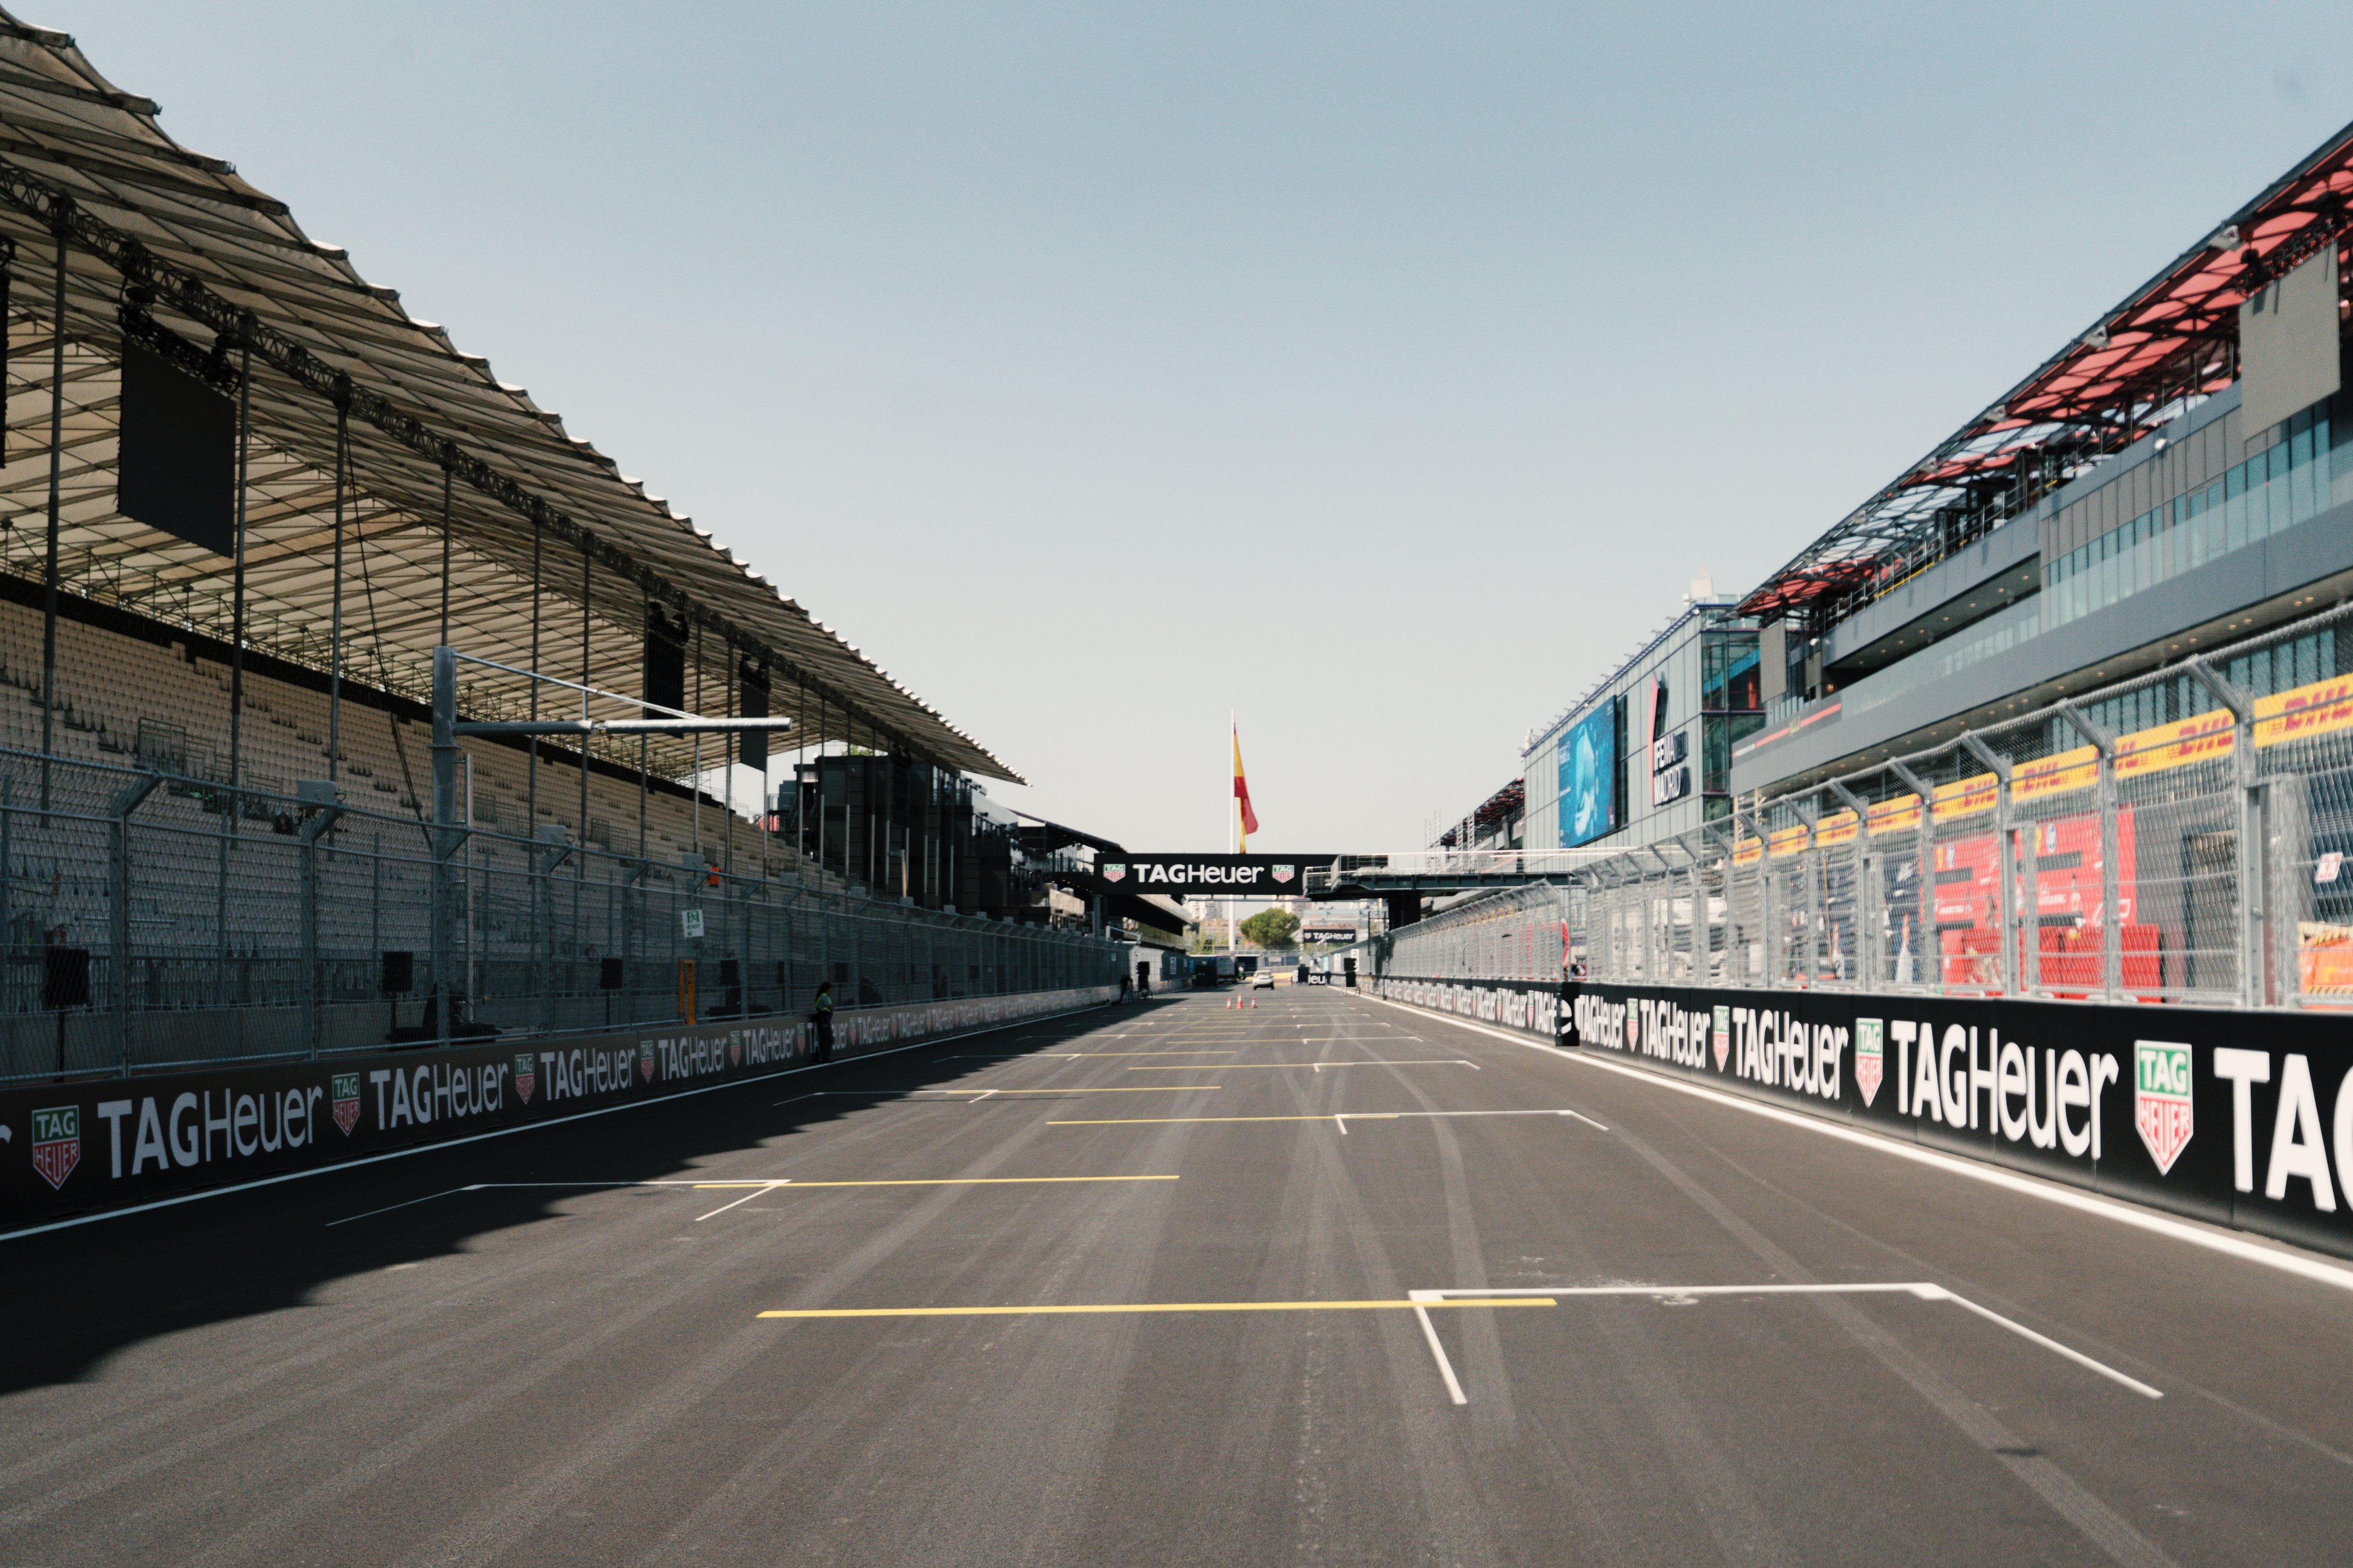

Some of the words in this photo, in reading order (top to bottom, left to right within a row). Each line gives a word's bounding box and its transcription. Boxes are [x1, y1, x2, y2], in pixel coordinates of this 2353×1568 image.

[2284, 685, 2352, 732] DHL
[1654, 733, 1675, 771] IFEMA
[2179, 715, 2233, 756] DHL
[1654, 767, 1681, 805] MADRID
[1133, 864, 1264, 883] TAGHeuer
[1313, 932, 1355, 940] TAGHeuer
[1640, 999, 1710, 1068] TAGHeuer
[1715, 1010, 1728, 1030] TAG
[1859, 1024, 1881, 1052] TAG
[517, 1056, 533, 1073] TAG
[658, 1036, 727, 1080] TAGHeuer
[743, 1027, 794, 1065] TAGHeuer
[1733, 1007, 1849, 1100] TAGHeuer
[335, 1077, 357, 1098] TAG
[541, 1048, 635, 1100] TAGHeuer
[1858, 1058, 1881, 1098] HEUER
[1891, 1021, 2119, 1160] TAGHeuer
[2140, 1051, 2188, 1094] TAG
[334, 1101, 360, 1131] HEUER
[370, 1063, 508, 1130] TAGHeuer
[36, 1111, 75, 1139] TAG
[98, 1086, 323, 1178] TAGHeuer
[2140, 1099, 2190, 1162] HEUER
[35, 1143, 78, 1182] HEUER
